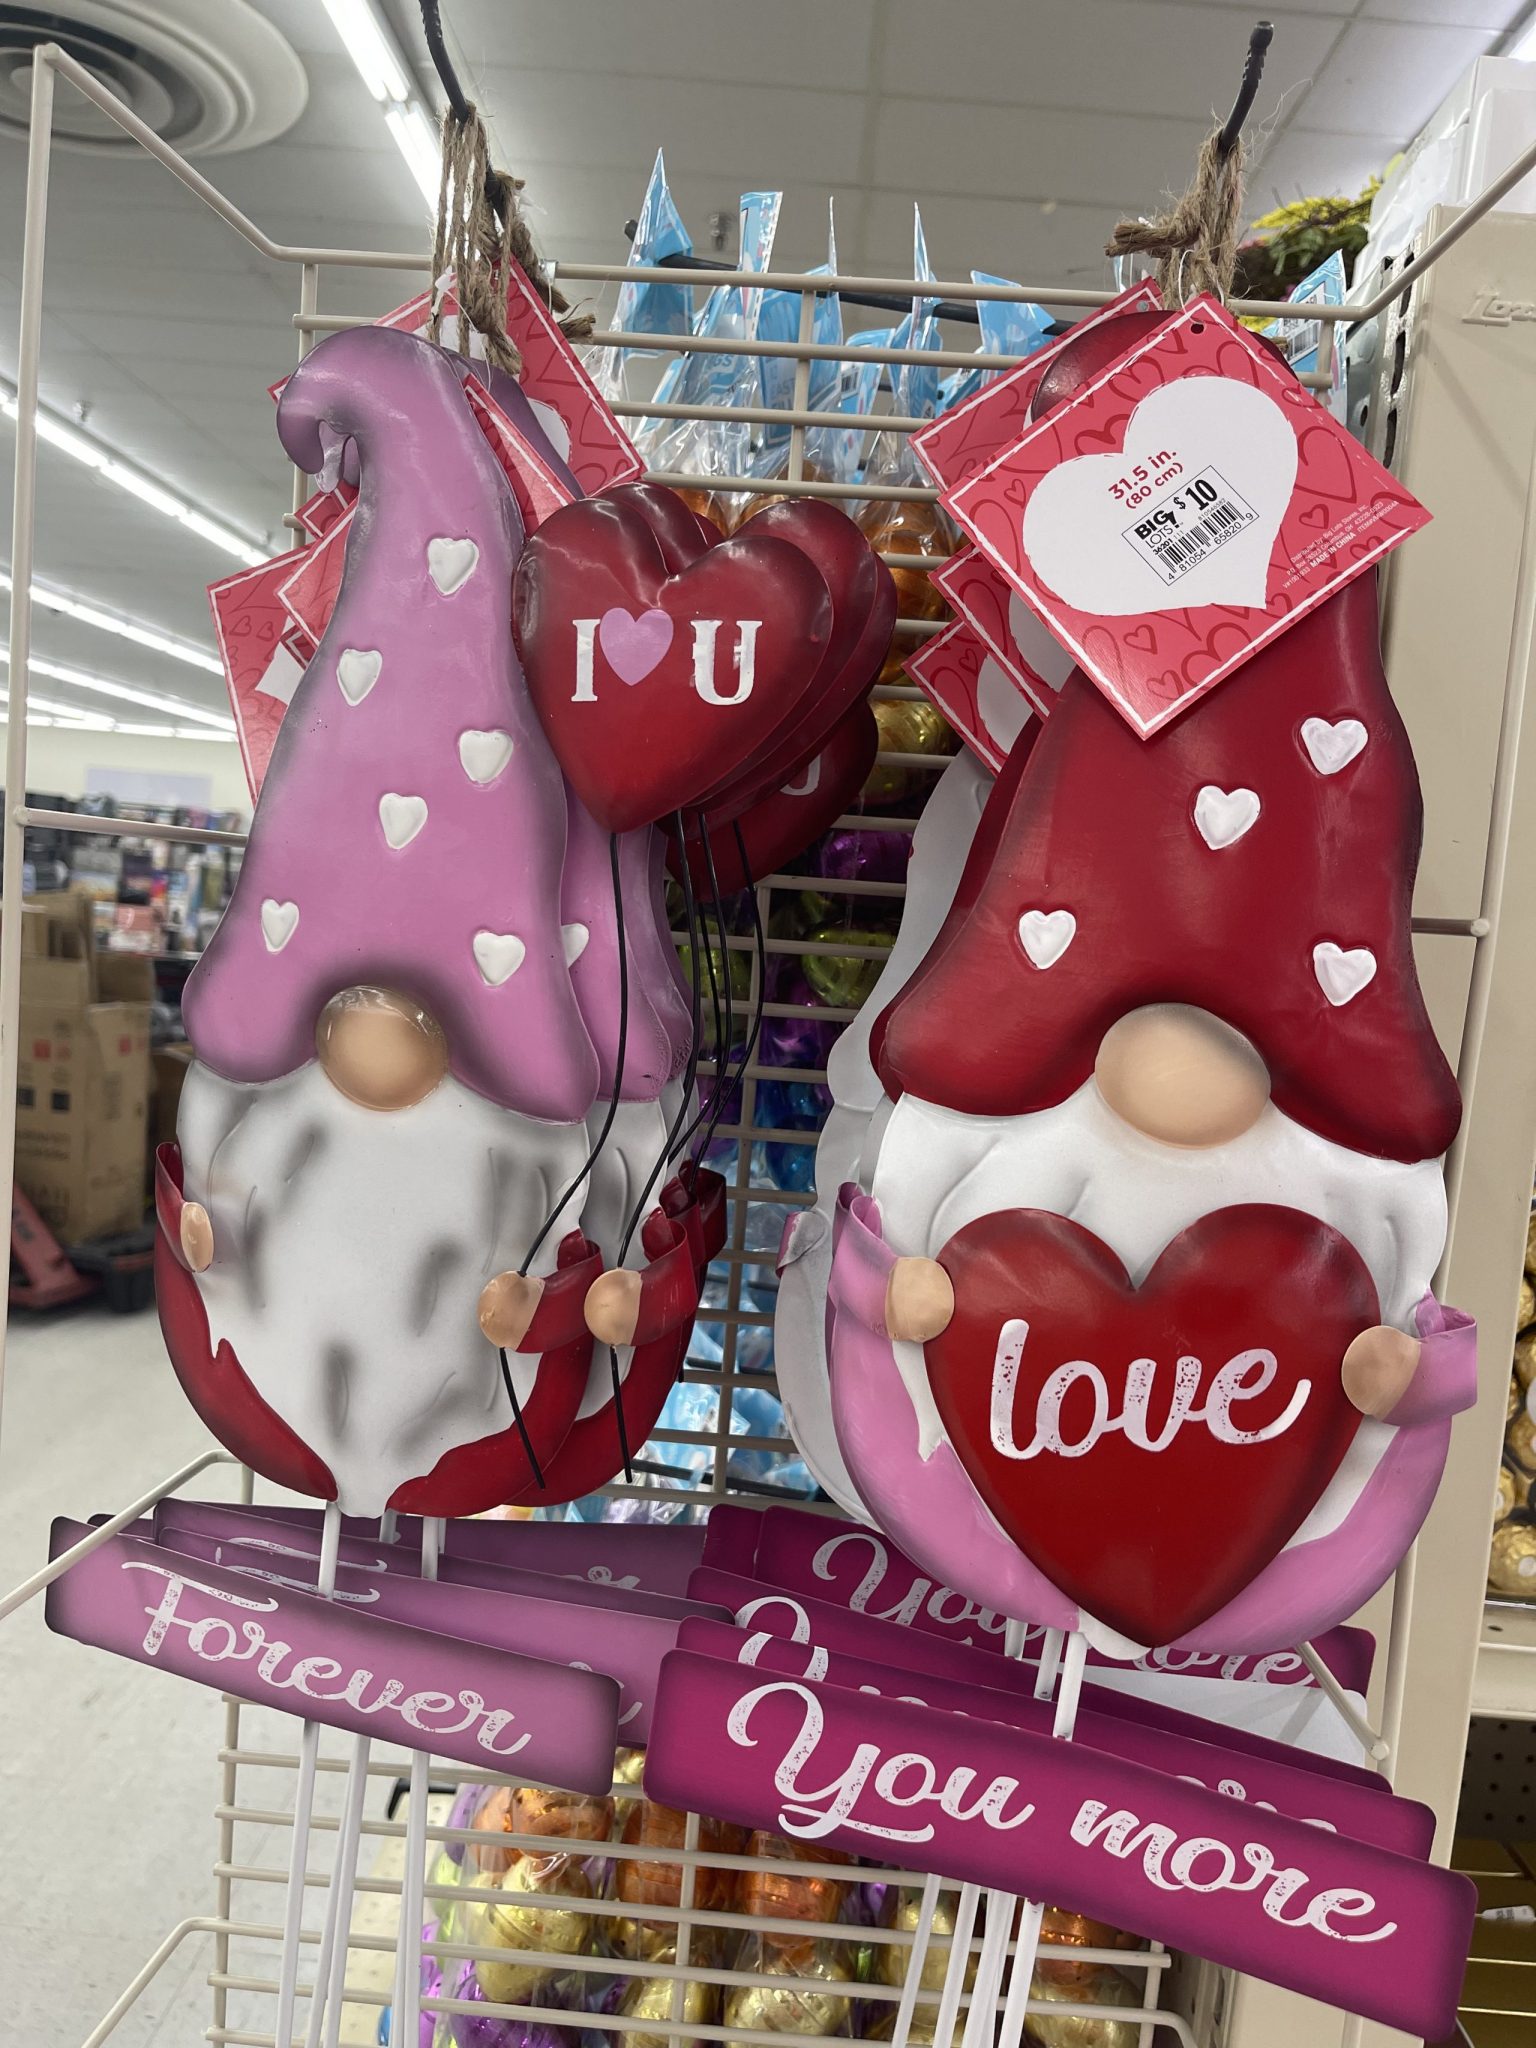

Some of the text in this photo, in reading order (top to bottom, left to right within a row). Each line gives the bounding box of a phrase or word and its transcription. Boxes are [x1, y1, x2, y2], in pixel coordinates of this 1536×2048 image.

[1108, 450, 1177, 500] 31.5 in.
[1125, 462, 1183, 509] (80 cm)
[1173, 479, 1218, 511] $ 10
[1134, 510, 1169, 540] BIG
[1152, 538, 1174, 556] 36201
[1167, 512, 1254, 581] 4 81054 65820 9
[1310, 551, 1330, 568] MADE
[1328, 546, 1337, 554] IN
[1335, 532, 1356, 548] CHINA
[571, 618, 763, 706] I U
[990, 1318, 1312, 1460] love
[121, 1561, 532, 1755] Forever
[727, 1681, 1036, 1843] You
[1071, 1798, 1398, 1943] more
